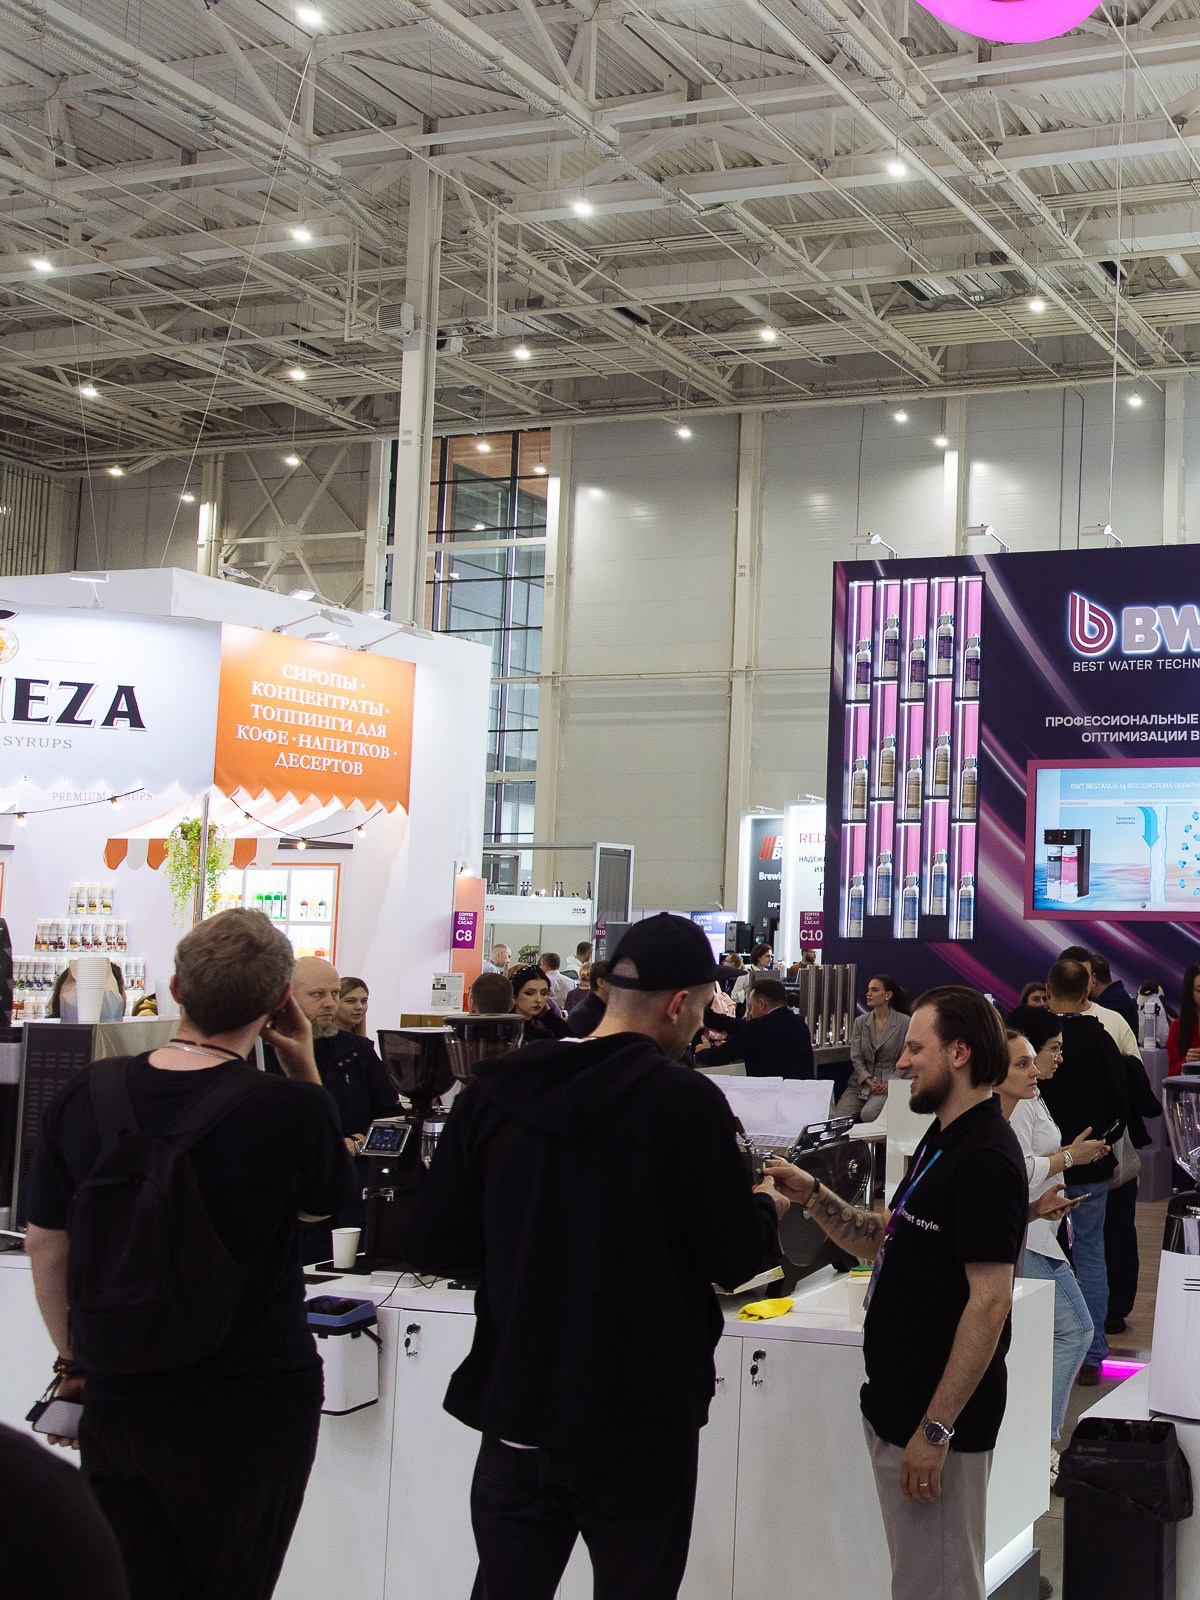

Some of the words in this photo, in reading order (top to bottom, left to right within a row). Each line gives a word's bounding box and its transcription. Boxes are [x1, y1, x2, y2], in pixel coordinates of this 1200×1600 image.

[1072, 661, 1105, 672] BEST
[1108, 660, 1153, 671] WATER
[281, 664, 359, 692] СИРОПЫ
[250, 703, 354, 733] ТОППИНГИ
[355, 720, 388, 739] ДЛЯ
[1045, 713, 1199, 727] ПРОФЕССИОНАЛЬНЫЕ
[3, 735, 73, 750] SYRUPS
[236, 724, 289, 746] КОФЕ
[297, 733, 391, 760] НАПИТКОВ
[1081, 730, 1188, 743] ОПТИМИЗАЦИИ
[274, 751, 364, 776] ДЕСЕРТОВ
[52, 792, 106, 802] PREMIUM
[455, 929, 473, 942] C8
[800, 929, 823, 942] C10
[916, 1219, 941, 1231] style.
